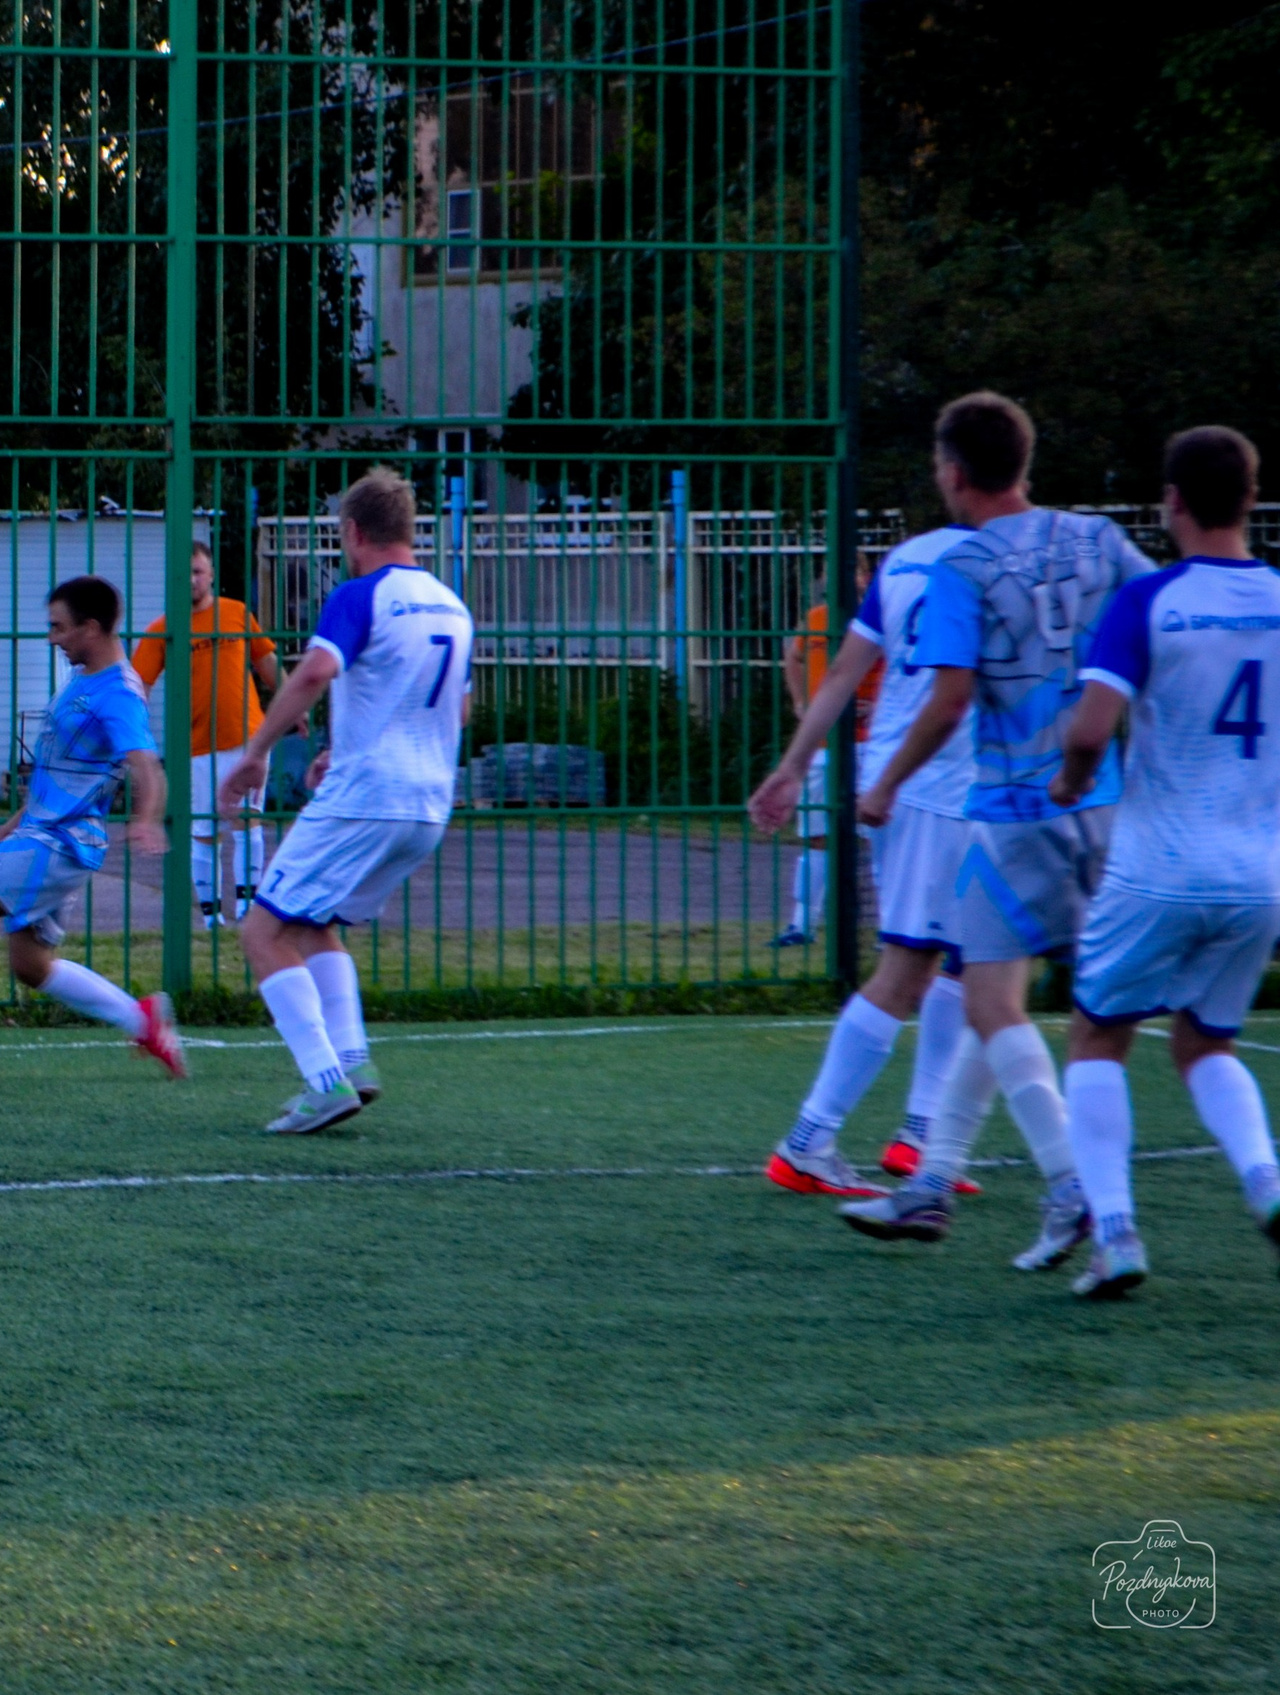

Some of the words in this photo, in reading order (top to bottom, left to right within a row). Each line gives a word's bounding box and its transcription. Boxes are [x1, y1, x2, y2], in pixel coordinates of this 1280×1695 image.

[427, 634, 455, 708] 7
[1212, 659, 1266, 760] 4
[268, 869, 285, 893] 7
